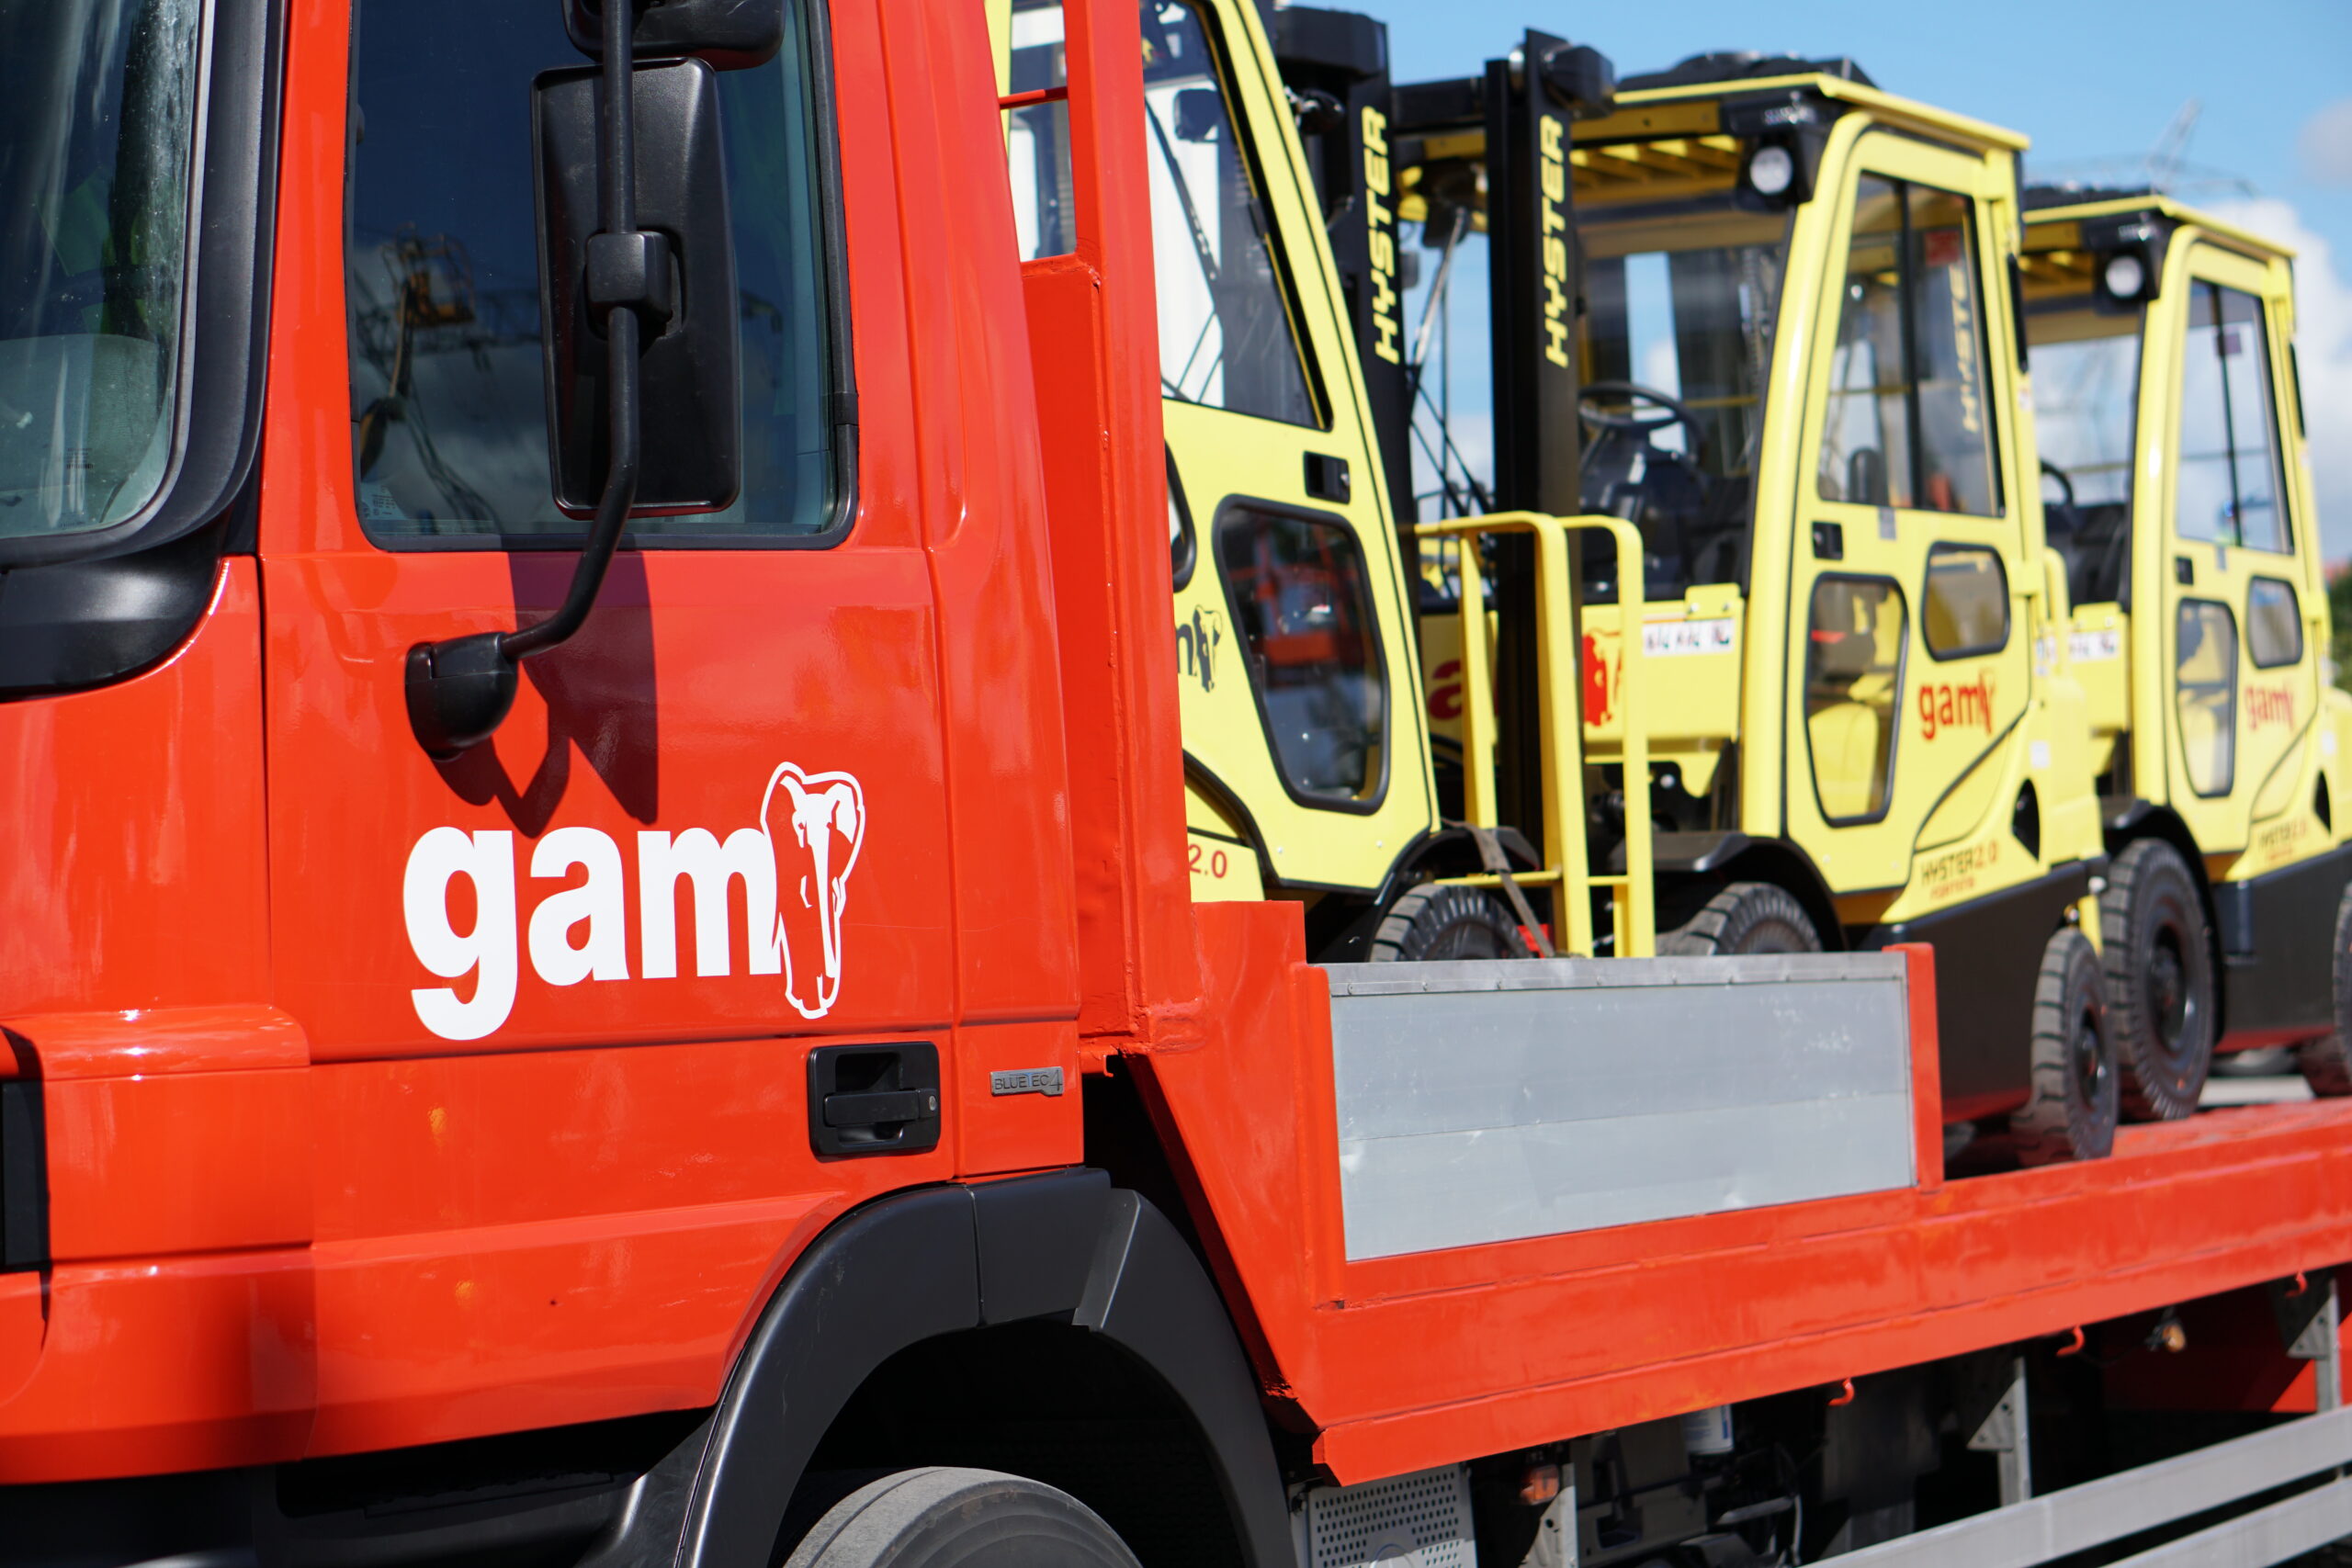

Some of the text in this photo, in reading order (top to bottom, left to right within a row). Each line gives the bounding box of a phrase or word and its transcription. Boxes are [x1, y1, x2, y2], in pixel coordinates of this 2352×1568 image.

[1362, 106, 1400, 365] HYSTER
[1540, 115, 1569, 368] HYSTER
[1918, 682, 1985, 740] gam
[402, 826, 782, 1041] gam
